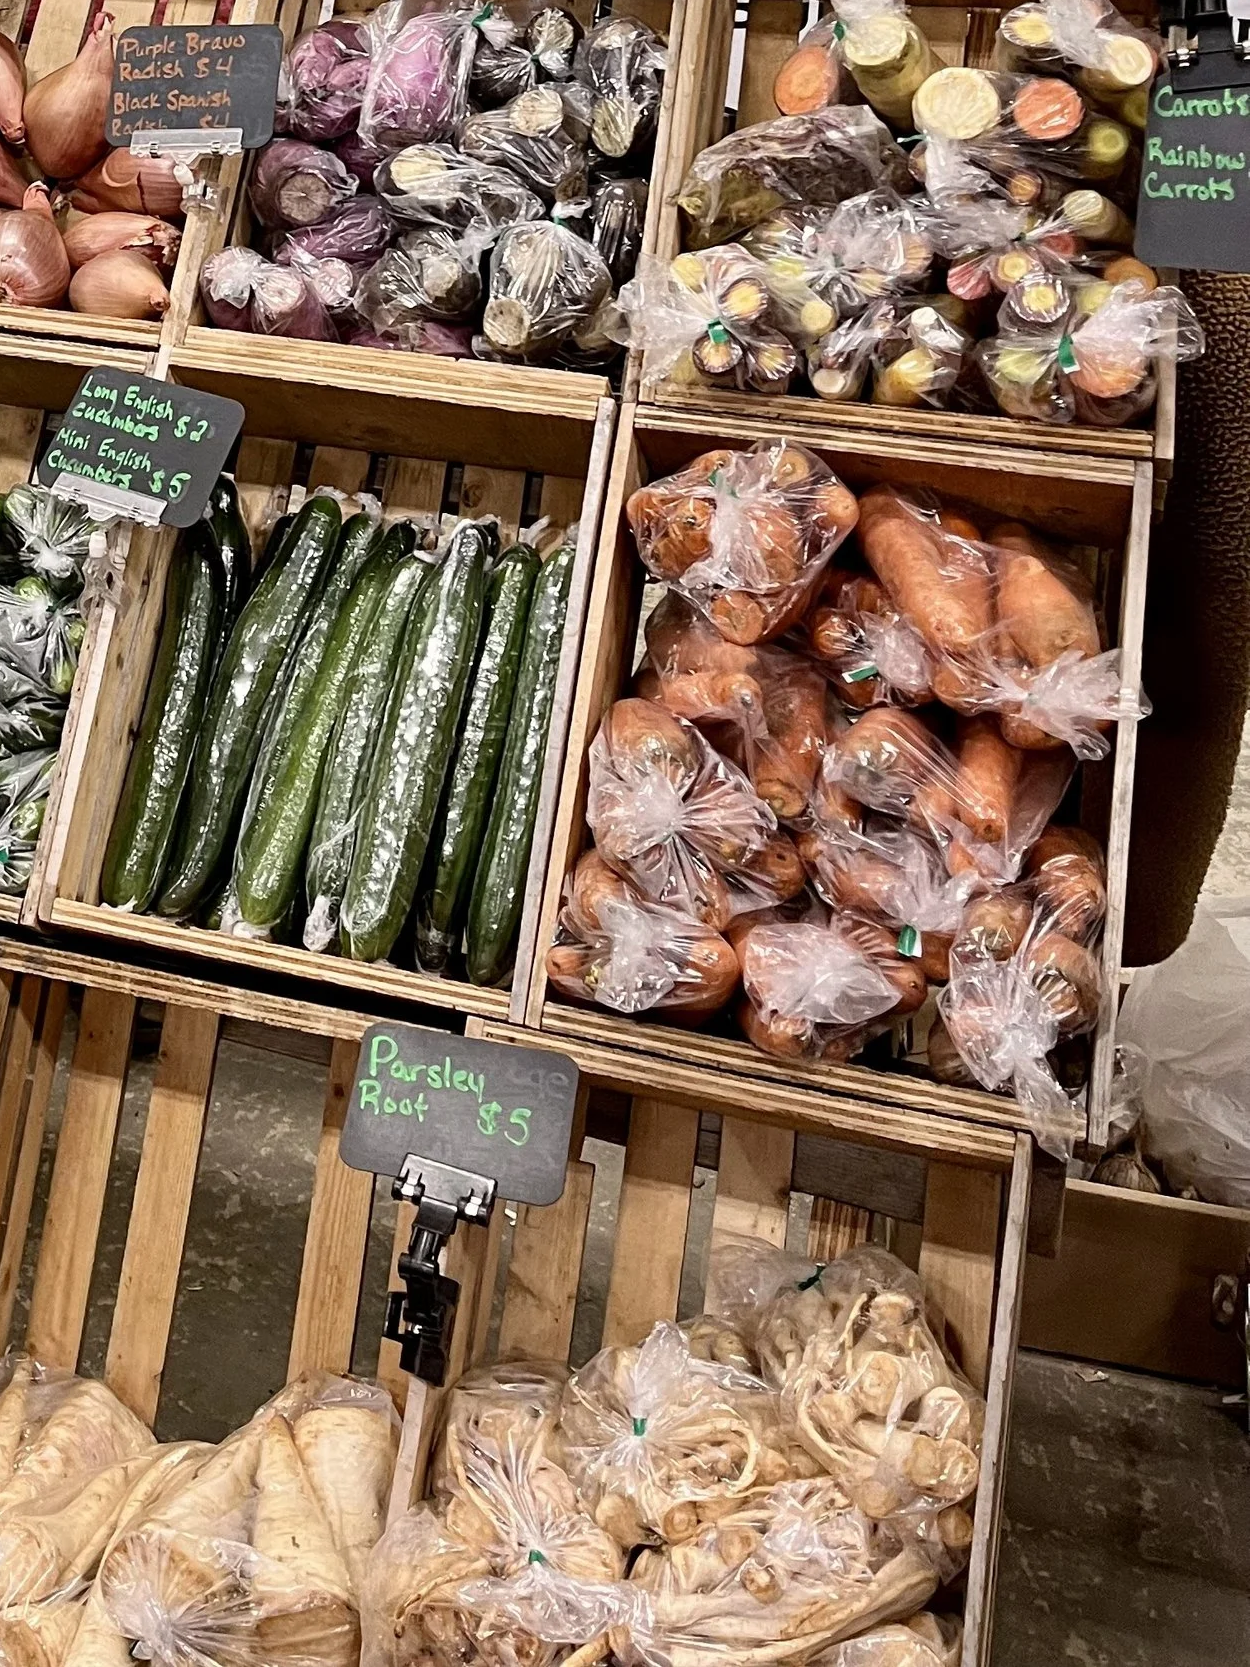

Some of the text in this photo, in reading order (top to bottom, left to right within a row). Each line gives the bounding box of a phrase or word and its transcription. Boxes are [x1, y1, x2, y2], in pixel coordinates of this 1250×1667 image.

[120, 34, 175, 61] Purple
[119, 60, 185, 82] Radish
[114, 89, 232, 115] Black Spanish
[1154, 85, 1250, 117] Carrots
[1148, 137, 1245, 170] Rainbow
[1144, 172, 1235, 201] Carrots
[81, 375, 174, 421] Long English
[56, 428, 151, 473] Mini English
[369, 1035, 485, 1103] Parsley
[359, 1079, 532, 1146] Root $5
